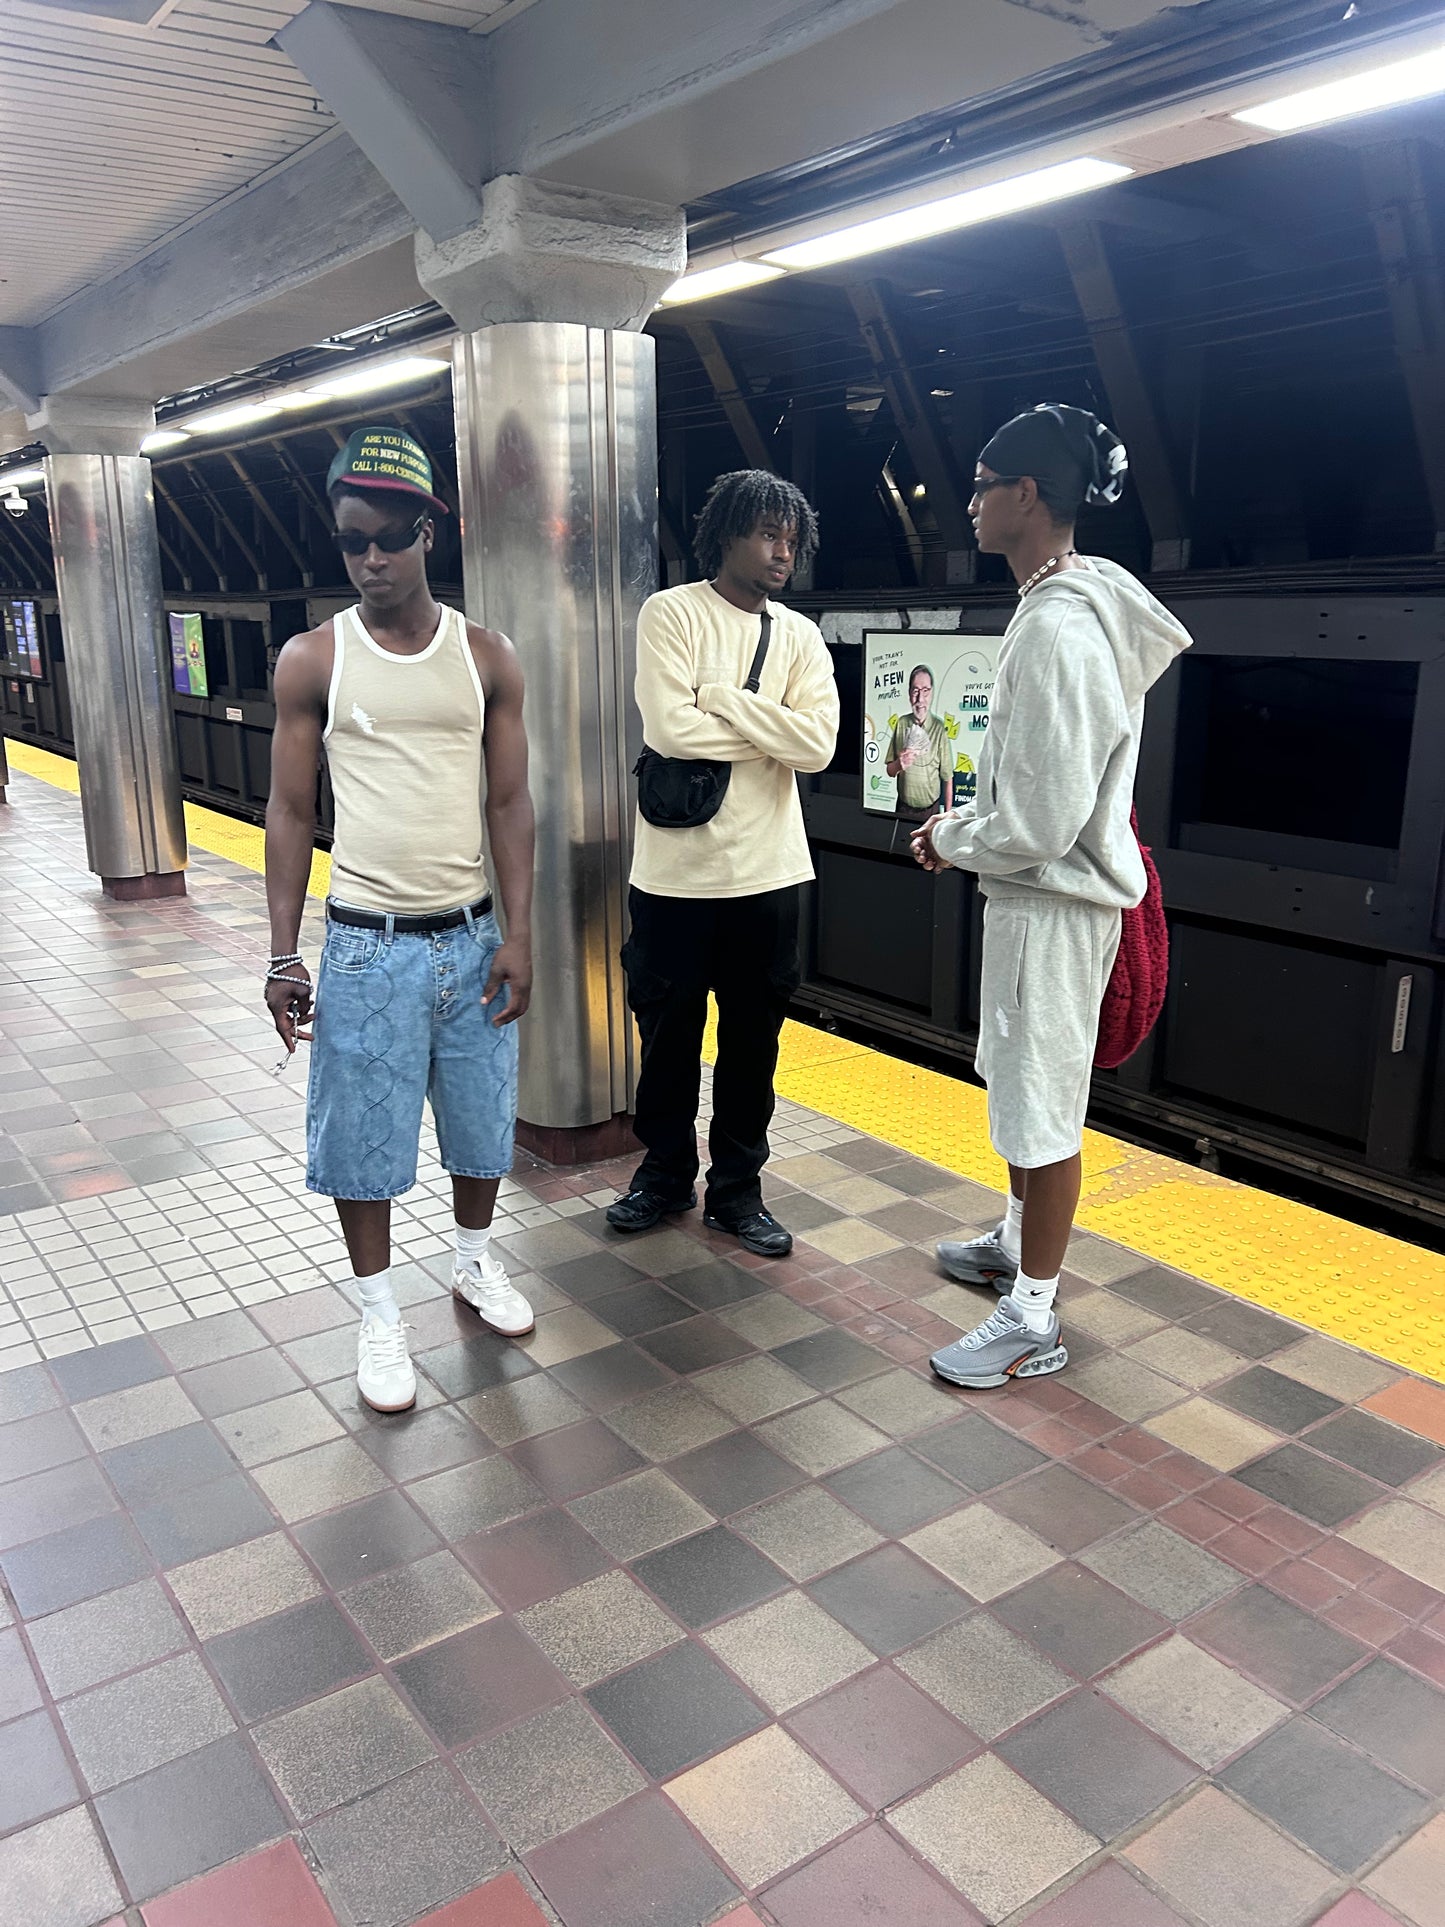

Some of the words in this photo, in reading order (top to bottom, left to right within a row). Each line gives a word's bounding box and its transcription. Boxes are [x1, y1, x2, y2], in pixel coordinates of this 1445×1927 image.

[364, 435, 382, 443] ARE
[383, 435, 401, 446] YOU
[360, 447, 379, 457] FOR
[379, 447, 401, 461] NEW
[352, 460, 373, 472] CALL
[874, 675, 881, 689] A
[883, 670, 904, 687] FEW
[965, 682, 983, 691] YOU'VE
[984, 682, 995, 690] GOT
[962, 694, 988, 708] FIND
[972, 714, 989, 728] MO
